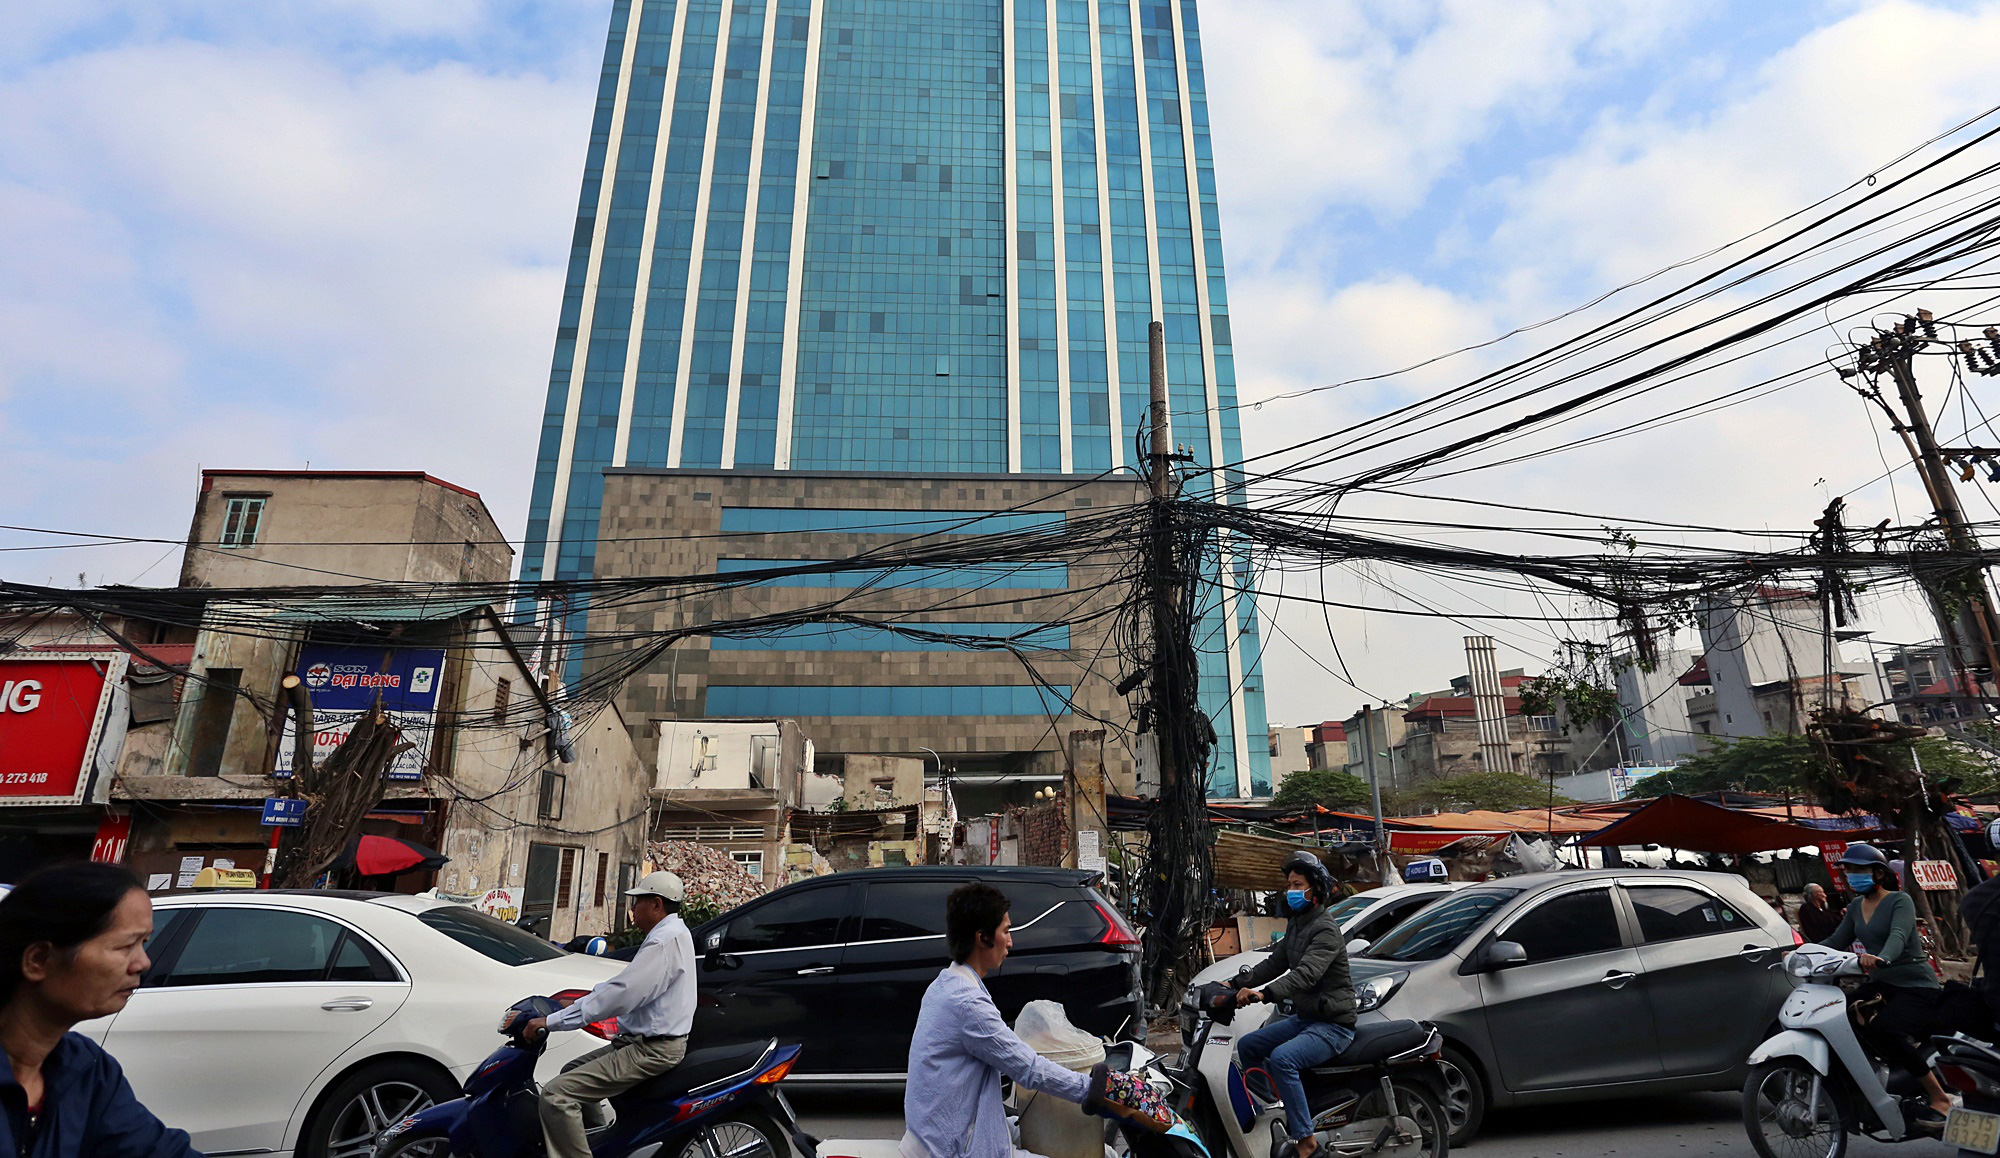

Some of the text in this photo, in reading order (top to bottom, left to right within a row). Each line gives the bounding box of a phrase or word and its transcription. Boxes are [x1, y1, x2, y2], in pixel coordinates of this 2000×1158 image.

[5, 773, 28, 784] 273
[28, 773, 48, 783] 418
[291, 803, 295, 812] 1
[1823, 850, 1845, 862] KHÓ
[1921, 861, 1957, 883] KHÓA
[1951, 1127, 1990, 1149] 9323
